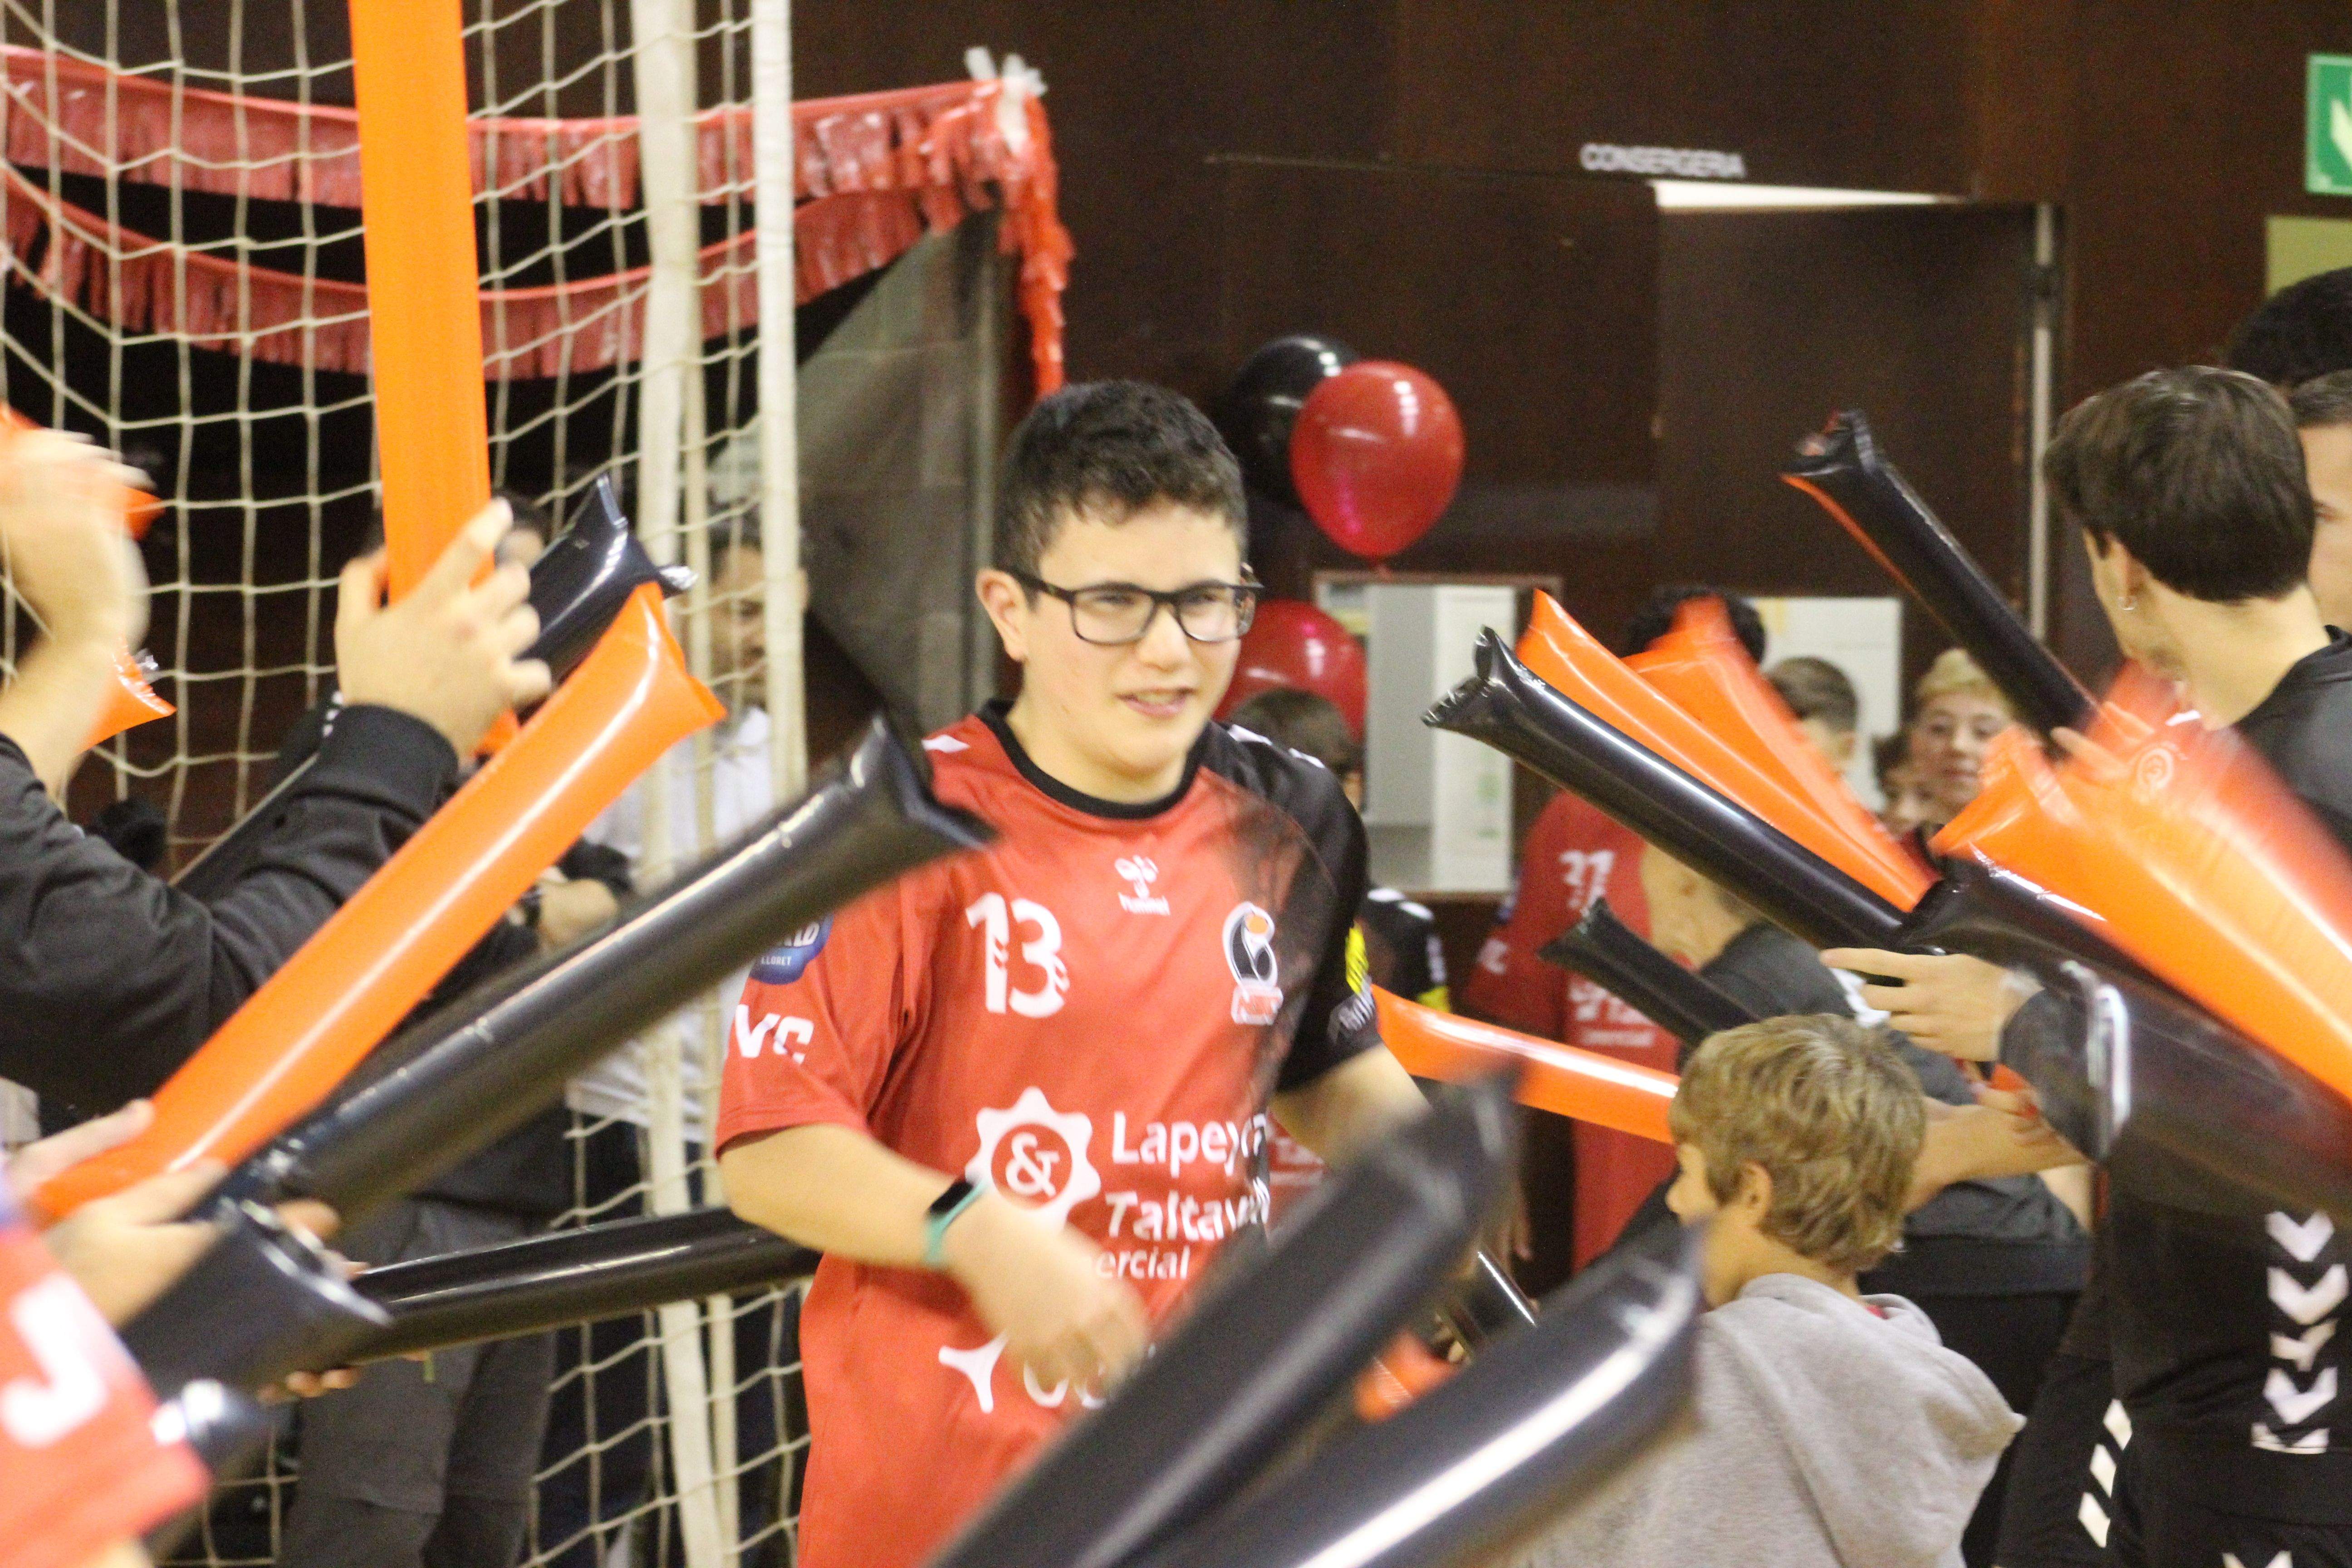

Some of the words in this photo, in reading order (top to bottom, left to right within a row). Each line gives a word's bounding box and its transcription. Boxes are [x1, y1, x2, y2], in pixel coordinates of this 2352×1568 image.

[965, 892, 1070, 1018] 13
[1004, 1132, 1059, 1197] &
[1096, 1245, 1191, 1280] ercial
